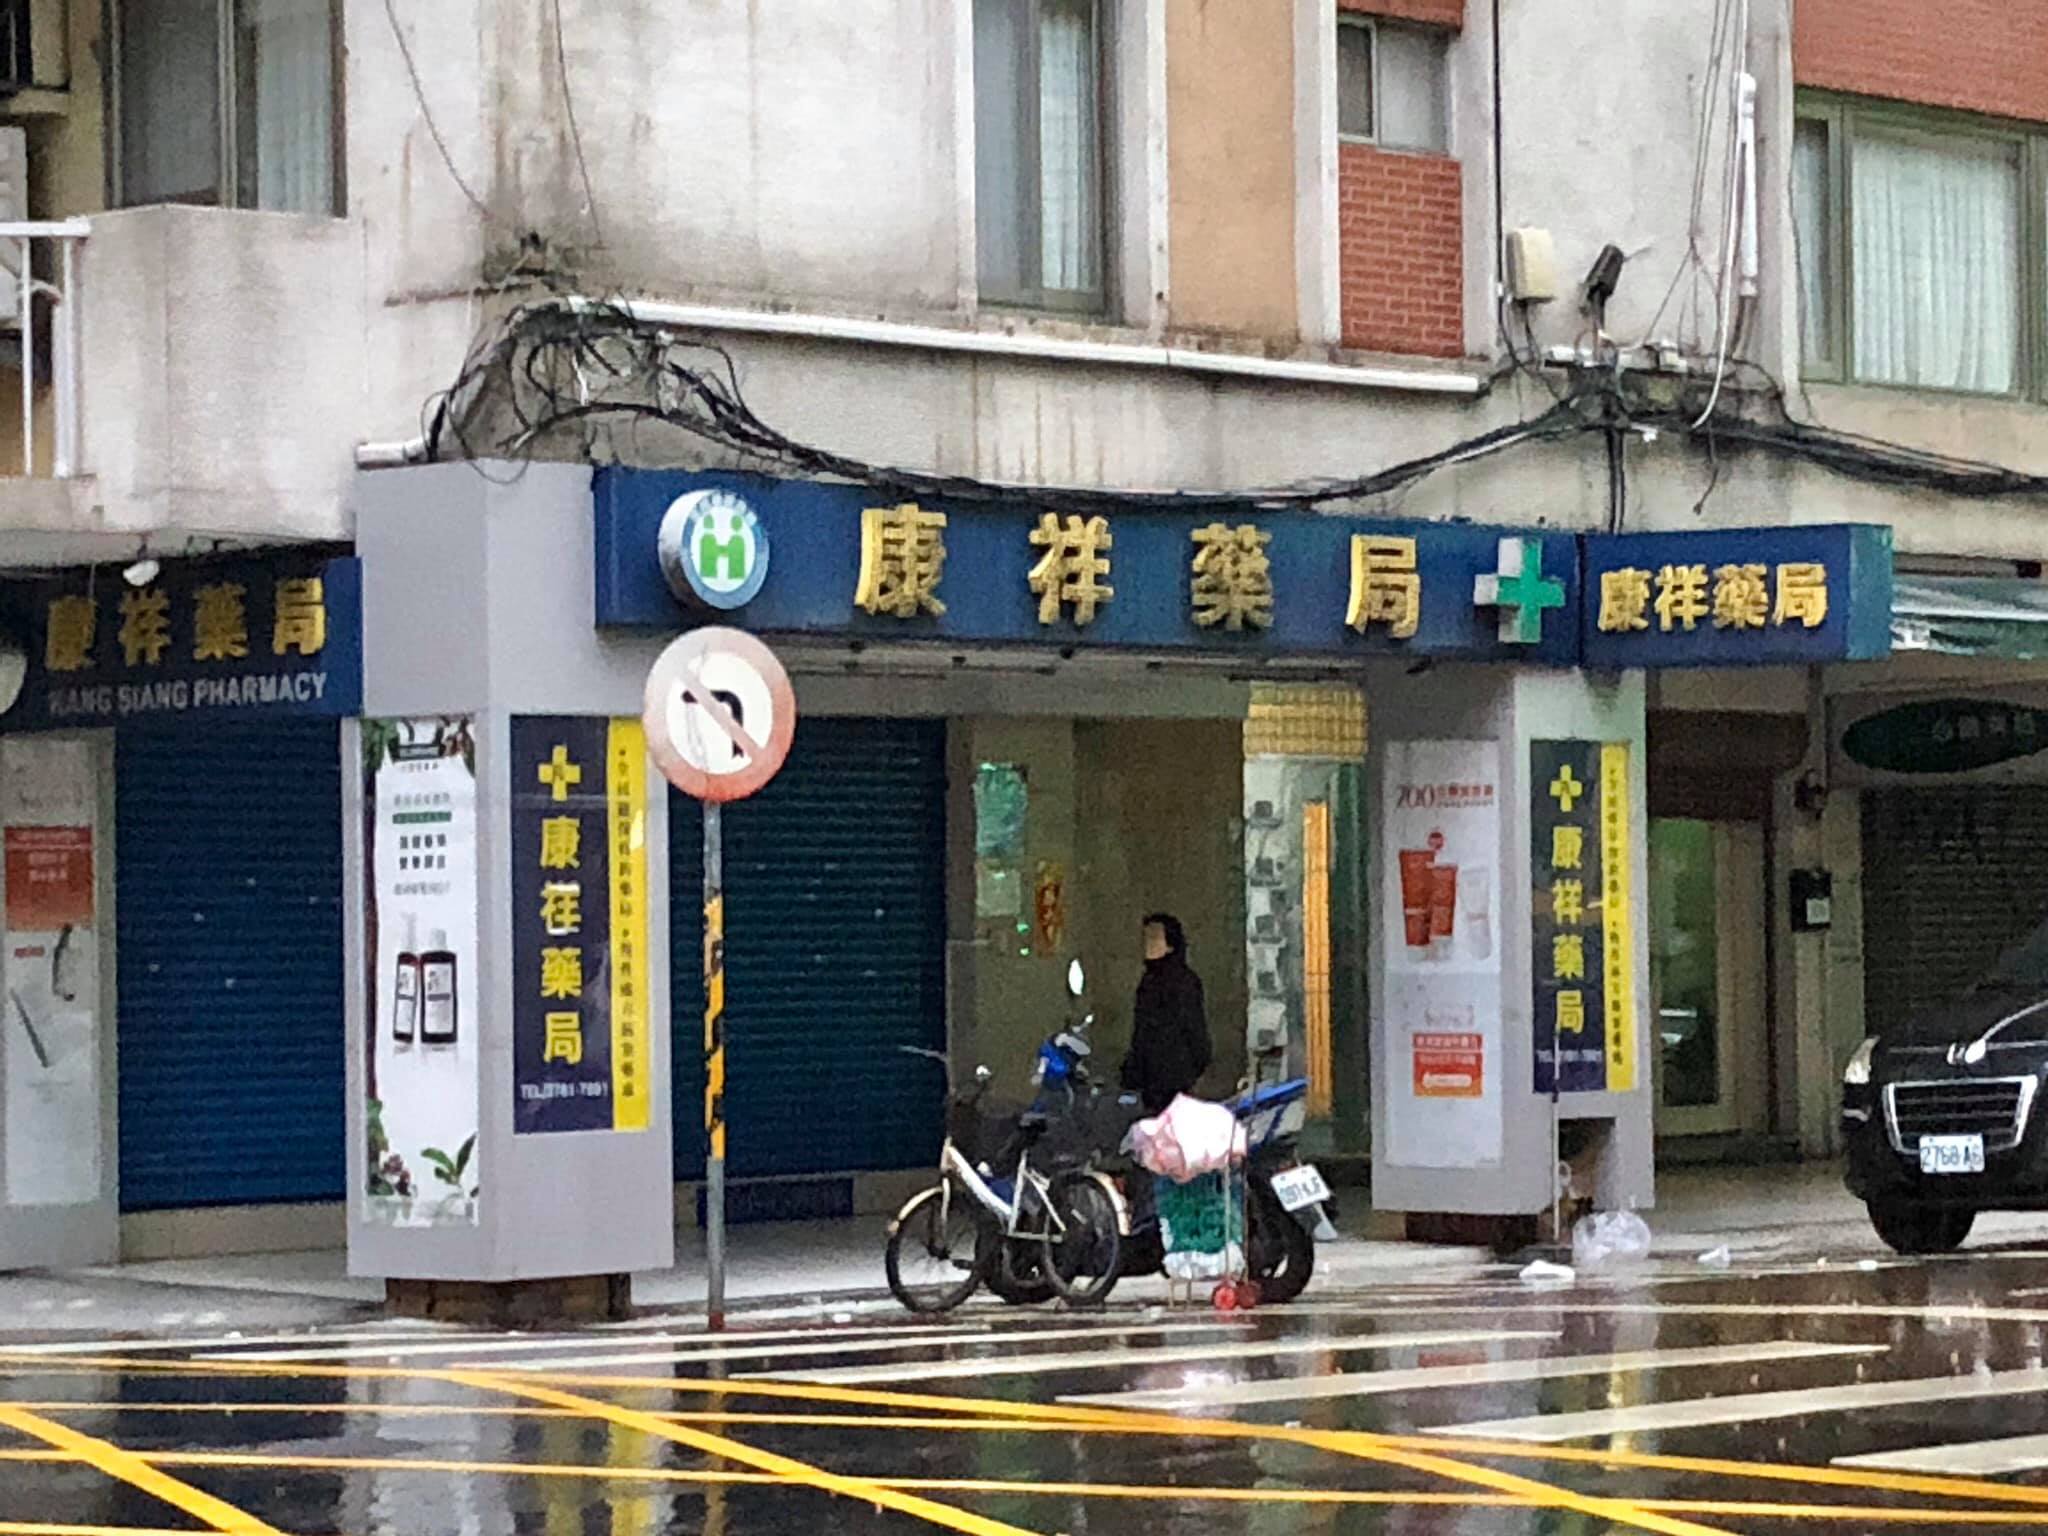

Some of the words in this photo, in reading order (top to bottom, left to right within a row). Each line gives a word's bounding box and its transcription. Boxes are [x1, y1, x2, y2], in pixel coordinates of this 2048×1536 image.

[855, 503, 1421, 639] 康祥藥局
[1598, 562, 1828, 632] 康祥藥局
[117, 679, 189, 712] SIANG
[192, 672, 328, 707] PHARMACY
